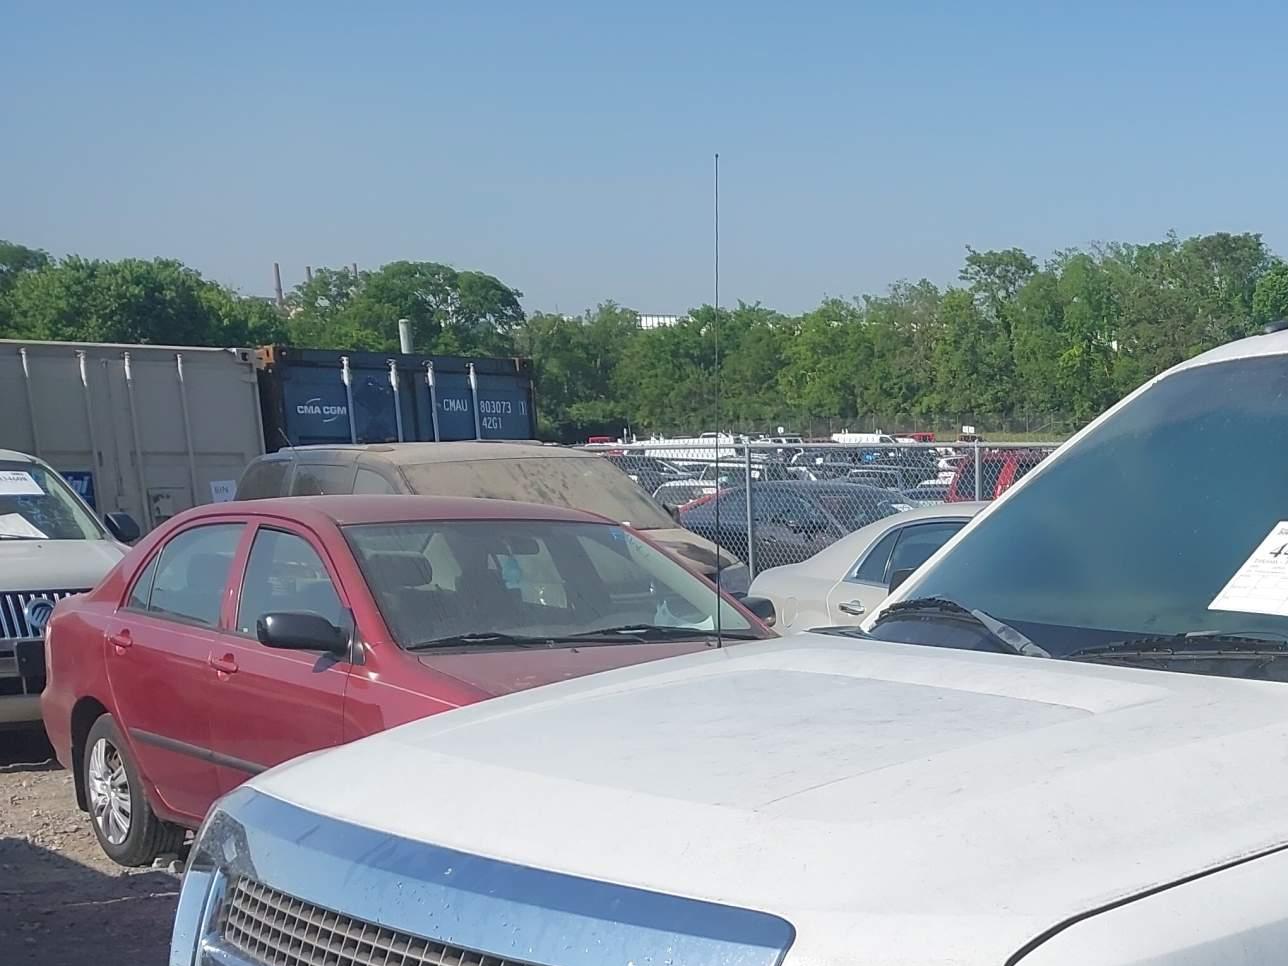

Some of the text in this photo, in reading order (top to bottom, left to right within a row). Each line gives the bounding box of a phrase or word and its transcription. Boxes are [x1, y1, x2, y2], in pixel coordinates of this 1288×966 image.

[297, 405, 347, 415] CMA CGM
[443, 399, 468, 412] CMAU
[479, 400, 512, 414] 803073
[481, 416, 502, 430] 42G1
